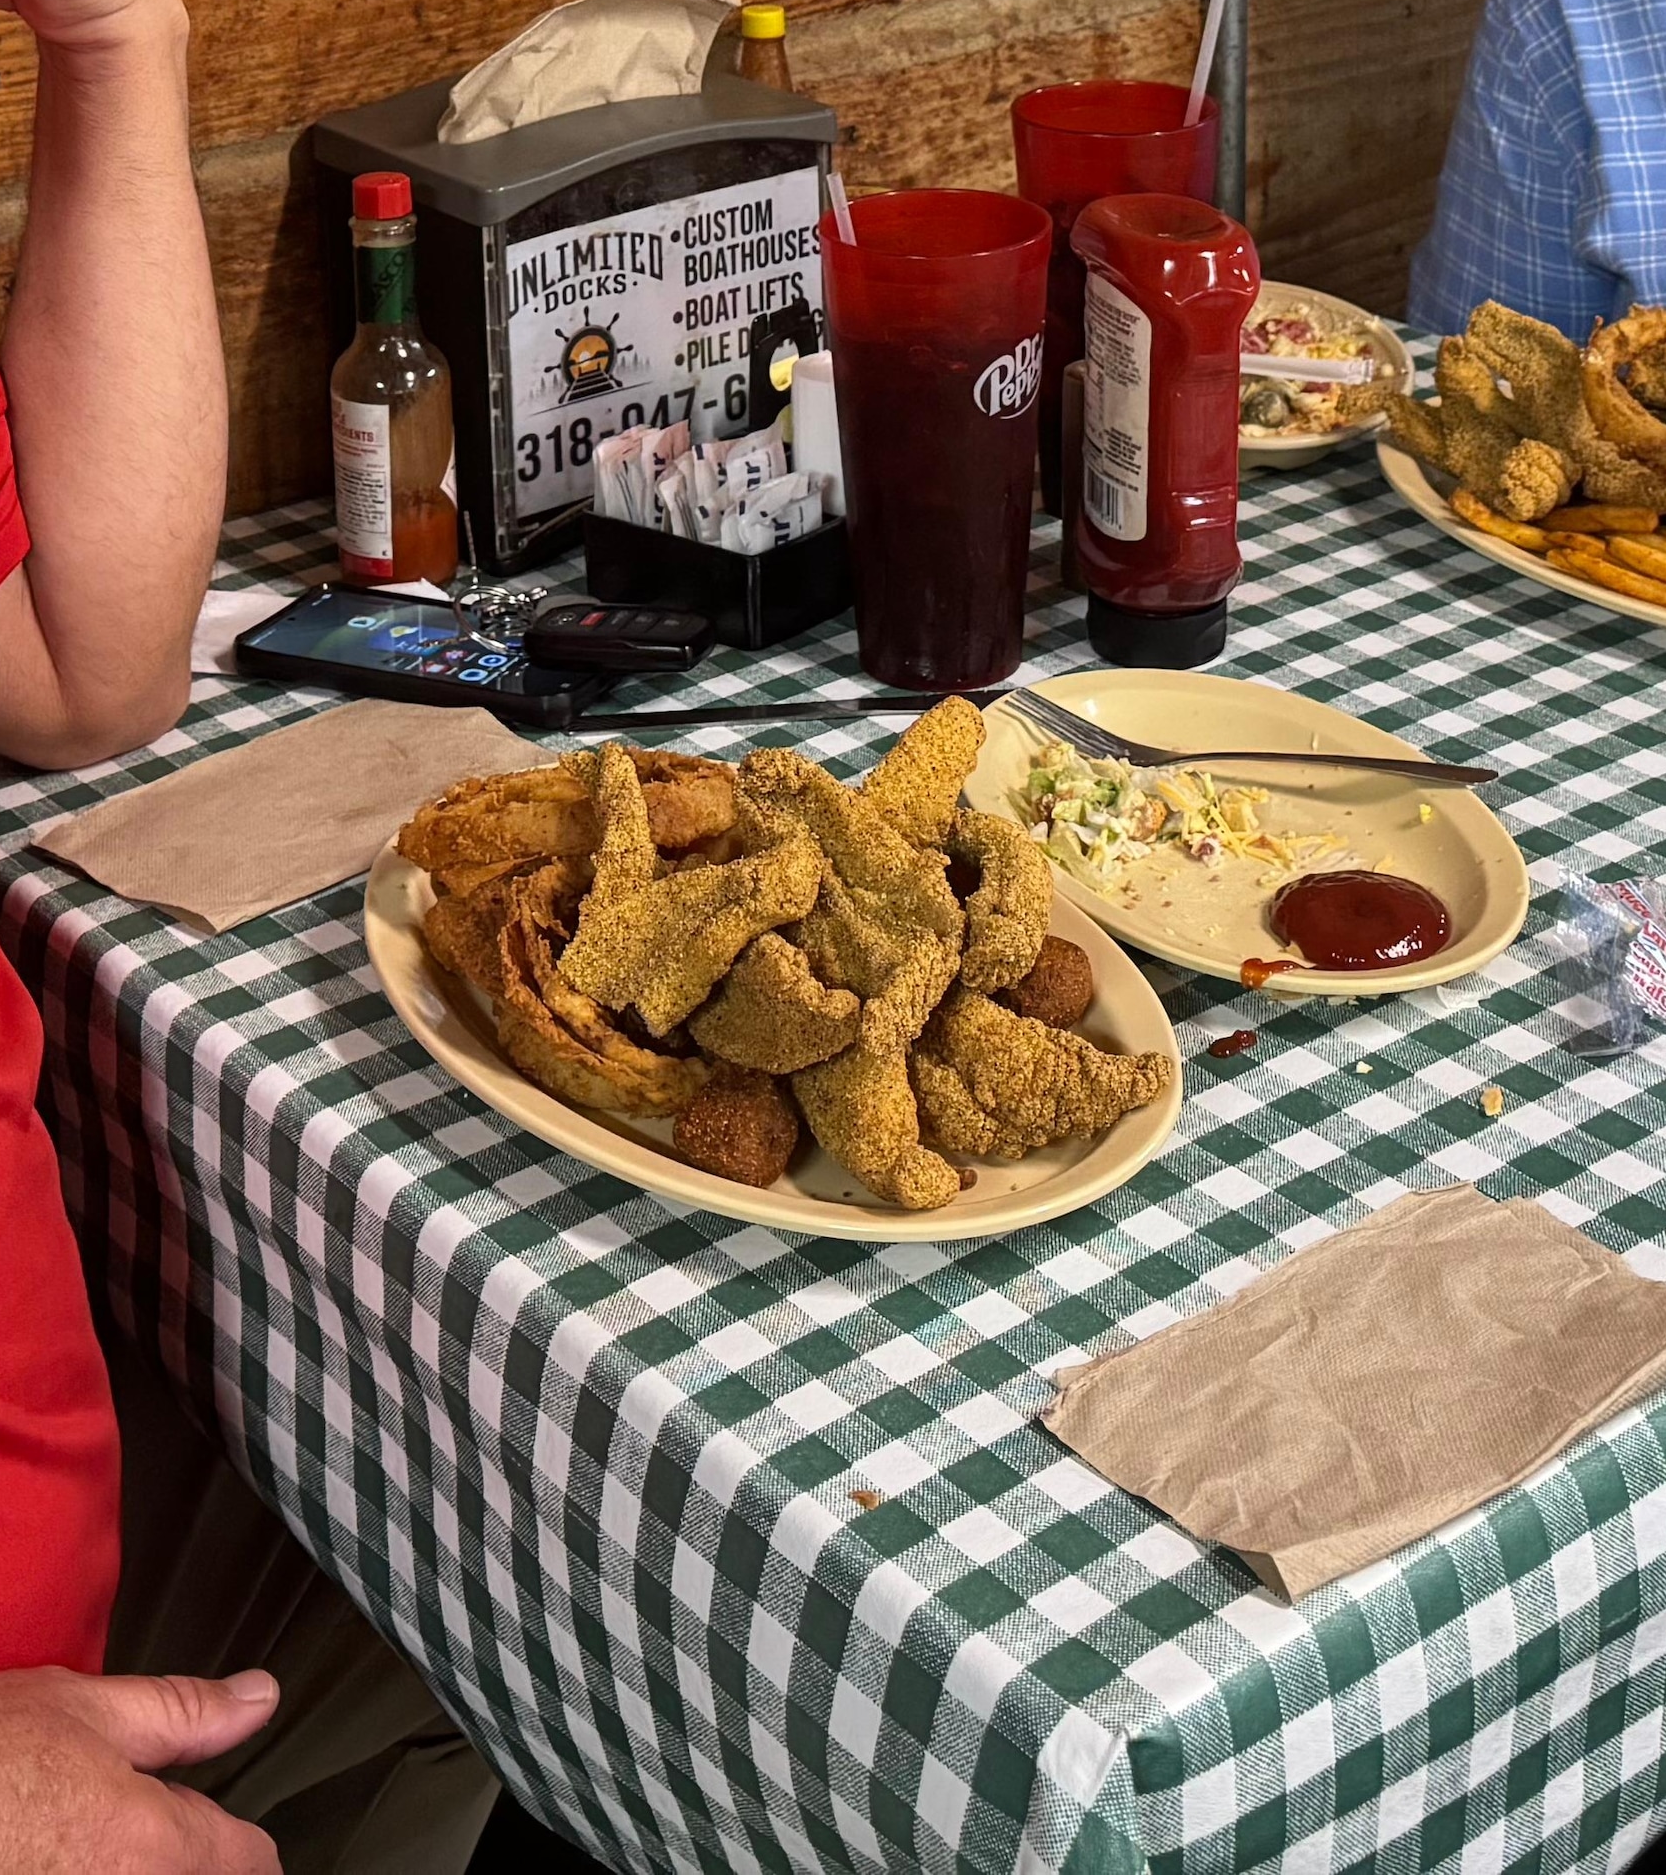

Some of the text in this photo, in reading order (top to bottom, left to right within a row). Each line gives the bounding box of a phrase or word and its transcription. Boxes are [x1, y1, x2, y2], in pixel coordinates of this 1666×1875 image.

[684, 199, 773, 249] CUSTOM
[507, 231, 664, 320] UNLIMITED
[685, 225, 821, 287] BOATHOUSES
[544, 273, 628, 314] DOCKS
[685, 271, 805, 331] BOAT LIFTS
[686, 331, 731, 373] PILE
